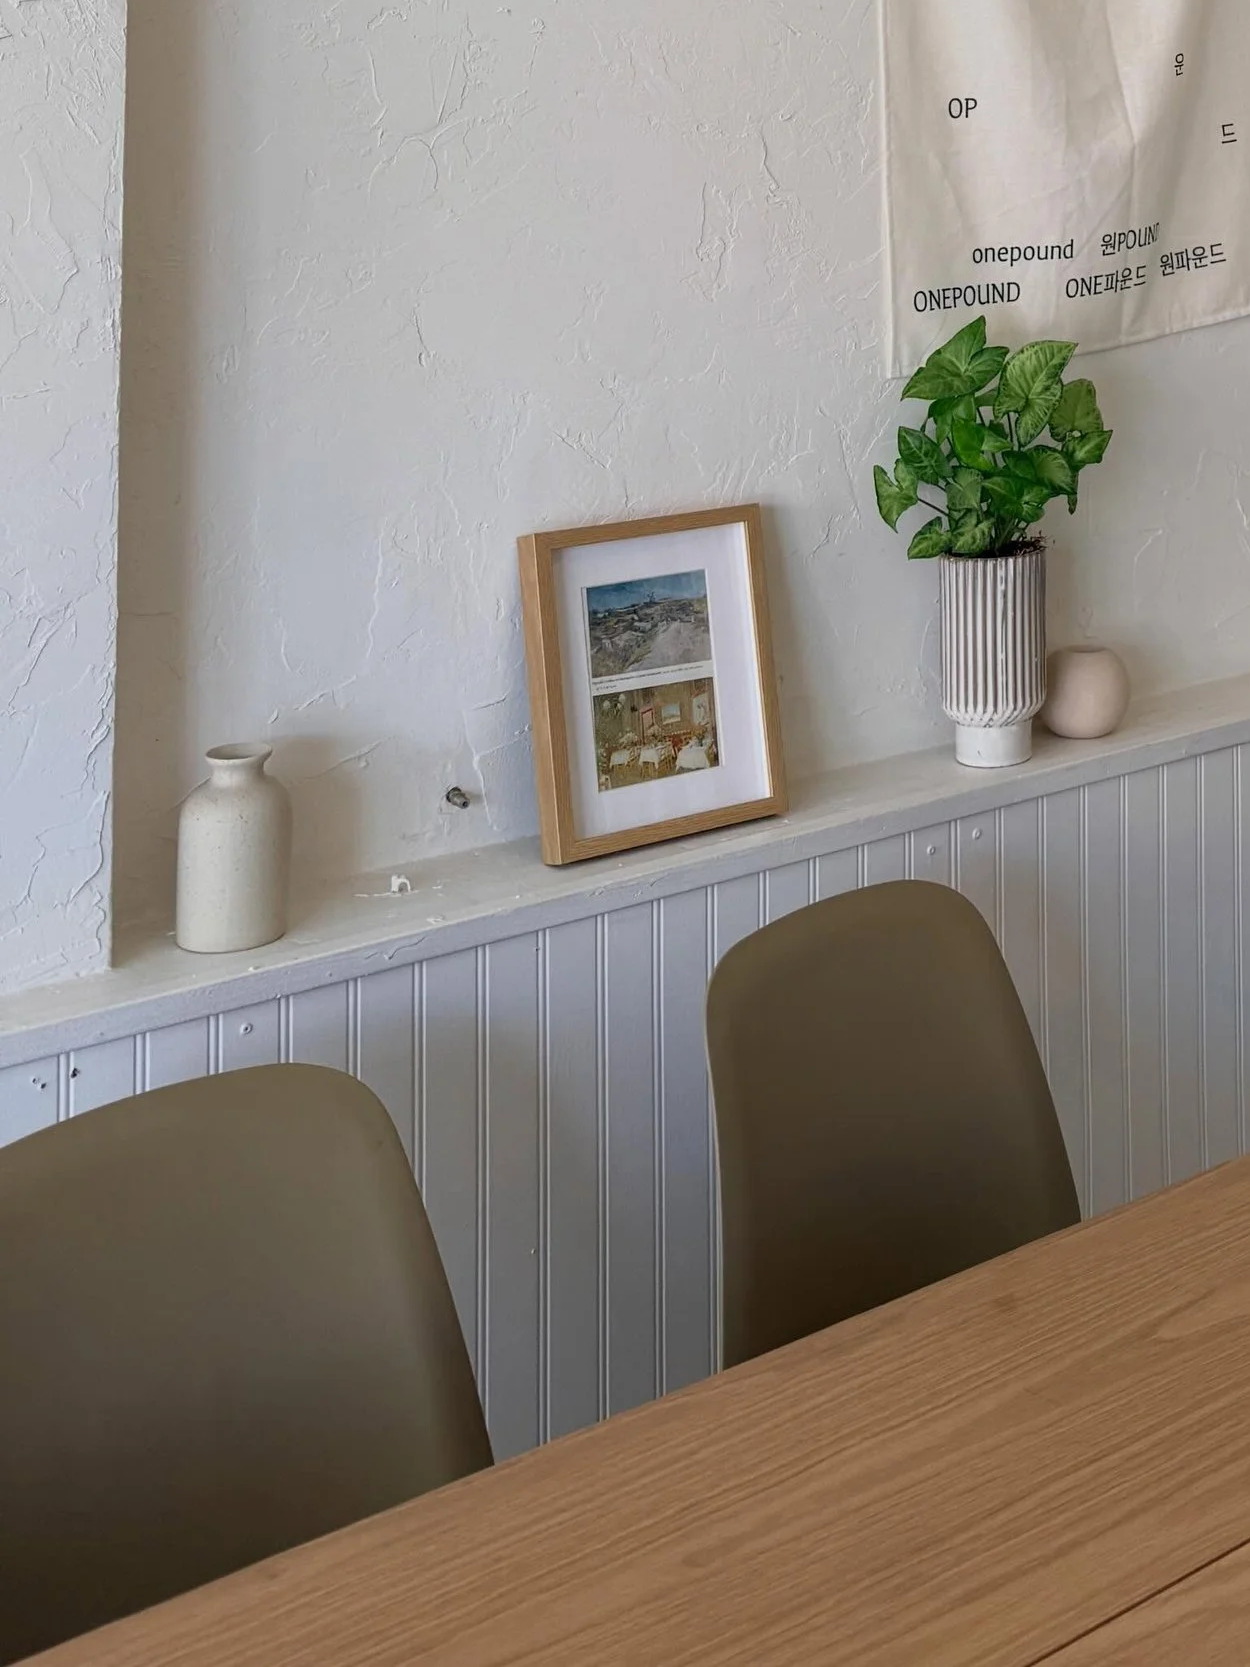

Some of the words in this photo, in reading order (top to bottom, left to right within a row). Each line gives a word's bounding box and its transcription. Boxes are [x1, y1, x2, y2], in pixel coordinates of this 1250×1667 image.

[1174, 52, 1185, 77] 운
[947, 97, 978, 120] OP
[1221, 123, 1238, 145] 드
[972, 239, 1075, 274] onepound
[913, 281, 1021, 313] ONEPOUND
[1065, 265, 1147, 299] ONE파운드
[1159, 243, 1227, 277] 원파운드
